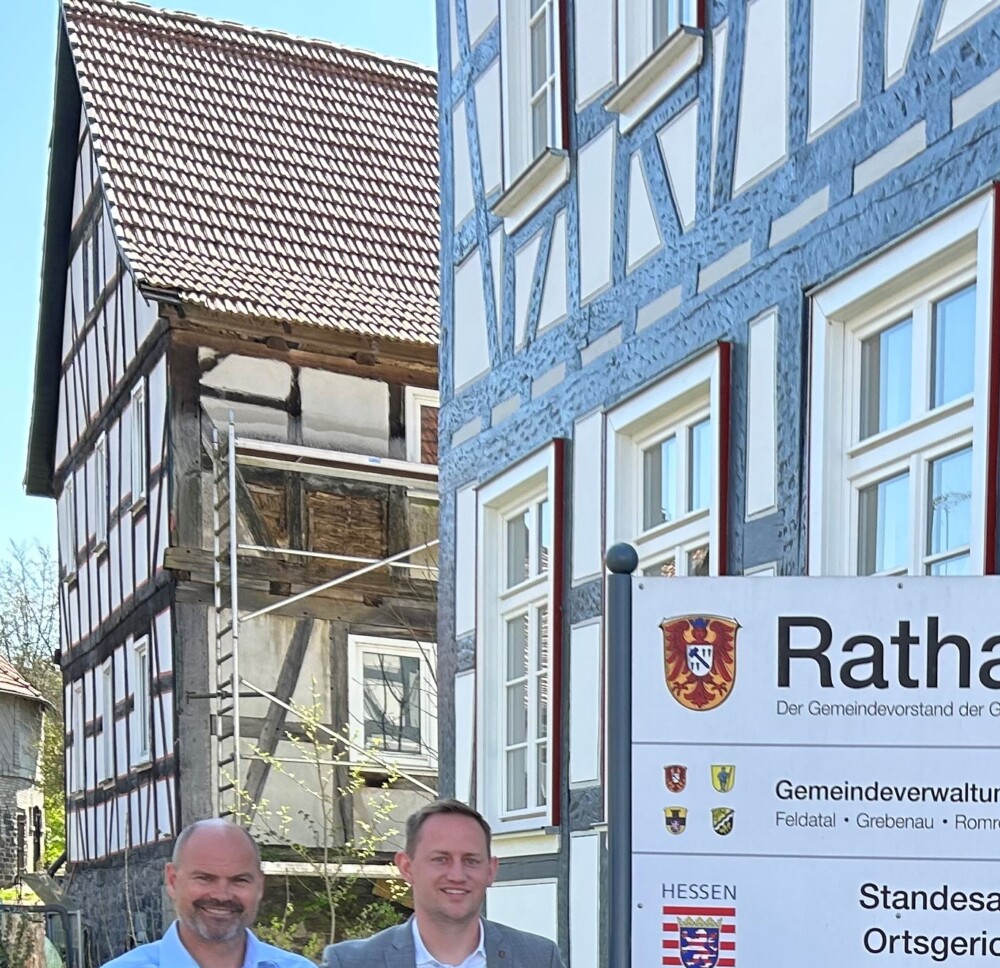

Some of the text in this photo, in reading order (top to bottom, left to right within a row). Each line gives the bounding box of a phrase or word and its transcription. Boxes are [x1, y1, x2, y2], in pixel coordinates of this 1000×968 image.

[777, 700, 804, 715] Der
[808, 700, 953, 716] Gemeindevorstand
[959, 702, 984, 716] der
[776, 811, 836, 827] Feldatal
[857, 813, 933, 829] Grebenau
[662, 883, 736, 900] HESSEN
